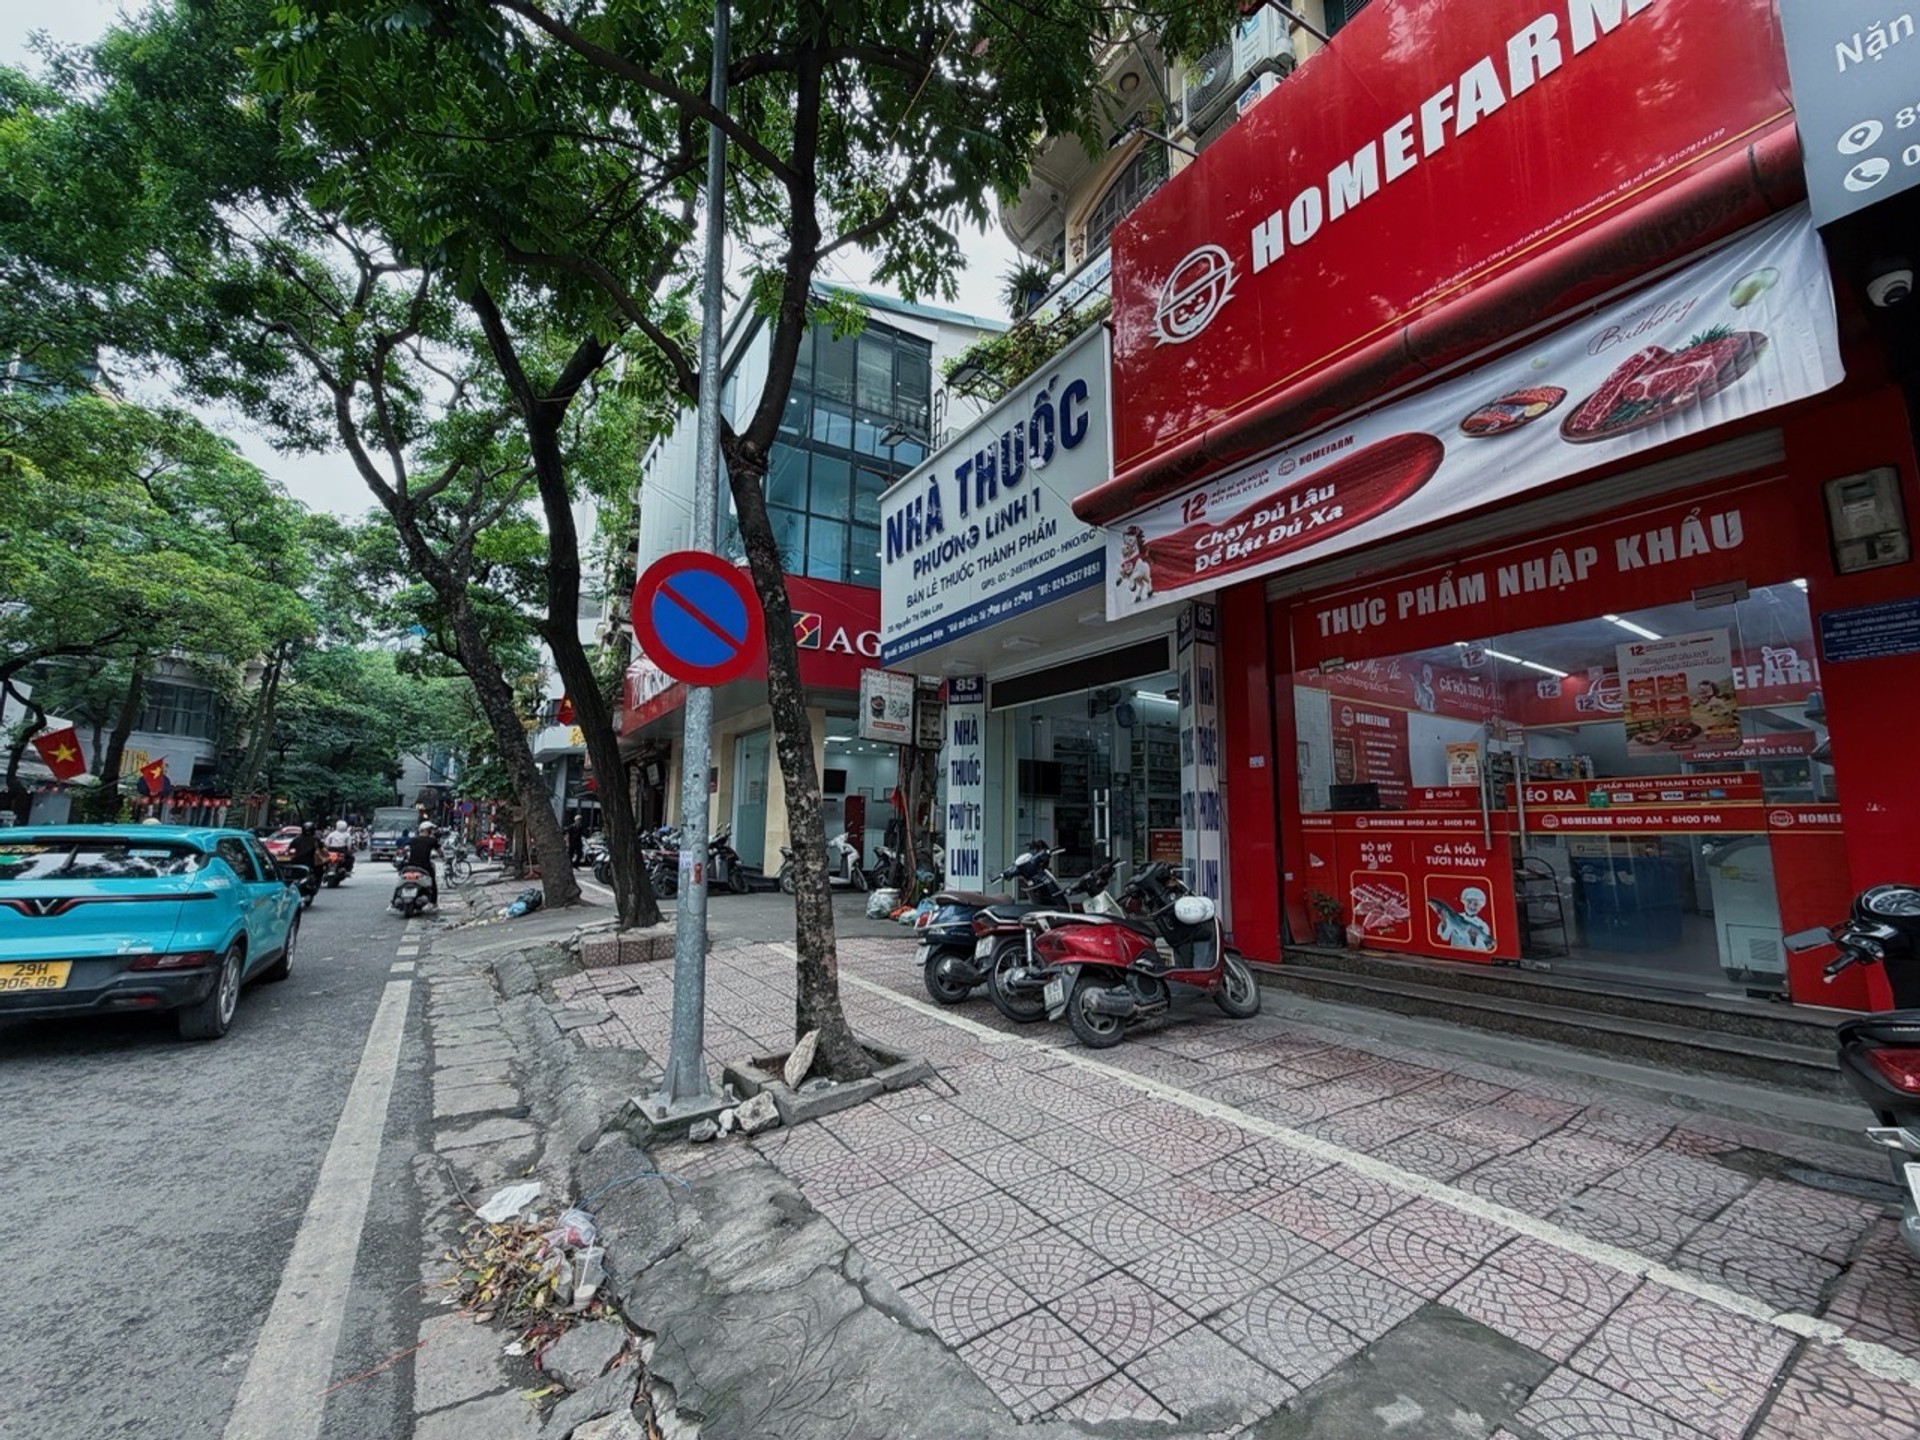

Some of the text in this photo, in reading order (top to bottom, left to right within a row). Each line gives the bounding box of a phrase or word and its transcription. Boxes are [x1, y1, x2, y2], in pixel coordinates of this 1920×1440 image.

[1896, 101, 1920, 129] 8
[1587, 295, 1699, 357] Birthday
[1298, 435, 1355, 466] HOMEFARM
[886, 374, 1089, 565] NHÀ THUỐC
[1181, 492, 1207, 524] 12
[1194, 482, 1336, 551] Chạy Đủ Lâu
[913, 486, 1041, 580] PHƯƠNG LINH 1
[1195, 503, 1344, 573] Để Bật Đủ Xa
[906, 515, 1057, 609] BÁN LẺ THUỐC THÀNH PHẨM
[1317, 507, 1744, 637] THỰC PHẨM NHẬP KHẨU
[1198, 606, 1212, 626] 85
[827, 626, 881, 657] AG
[1629, 645, 1645, 656] 12
[1464, 650, 1483, 666] 12
[1768, 653, 1792, 670] 12
[1733, 656, 1820, 690] EFAR
[955, 678, 977, 692] 85
[1539, 684, 1557, 696] 12
[1577, 700, 1595, 711] 12
[953, 714, 979, 746] NHÀ
[1778, 744, 1803, 755] KÈM
[951, 753, 980, 786] THUỐC
[1627, 778, 1653, 791] NHẬN
[1655, 777, 1689, 789] THANH
[1691, 775, 1722, 787] TOÁN
[1724, 774, 1743, 785] THẺ
[1553, 789, 1576, 802] RA
[1663, 792, 1683, 800] VISA
[1561, 815, 1613, 826] HOMEFARM
[1645, 815, 1663, 825] AM
[1703, 813, 1722, 824] PM
[1360, 841, 1392, 852] BÒ MỸ
[1434, 843, 1477, 855] CÁ HỒI
[951, 849, 979, 877] LINH
[1425, 855, 1487, 867] TƯƠI NAUY
[13, 963, 49, 977] 29H
